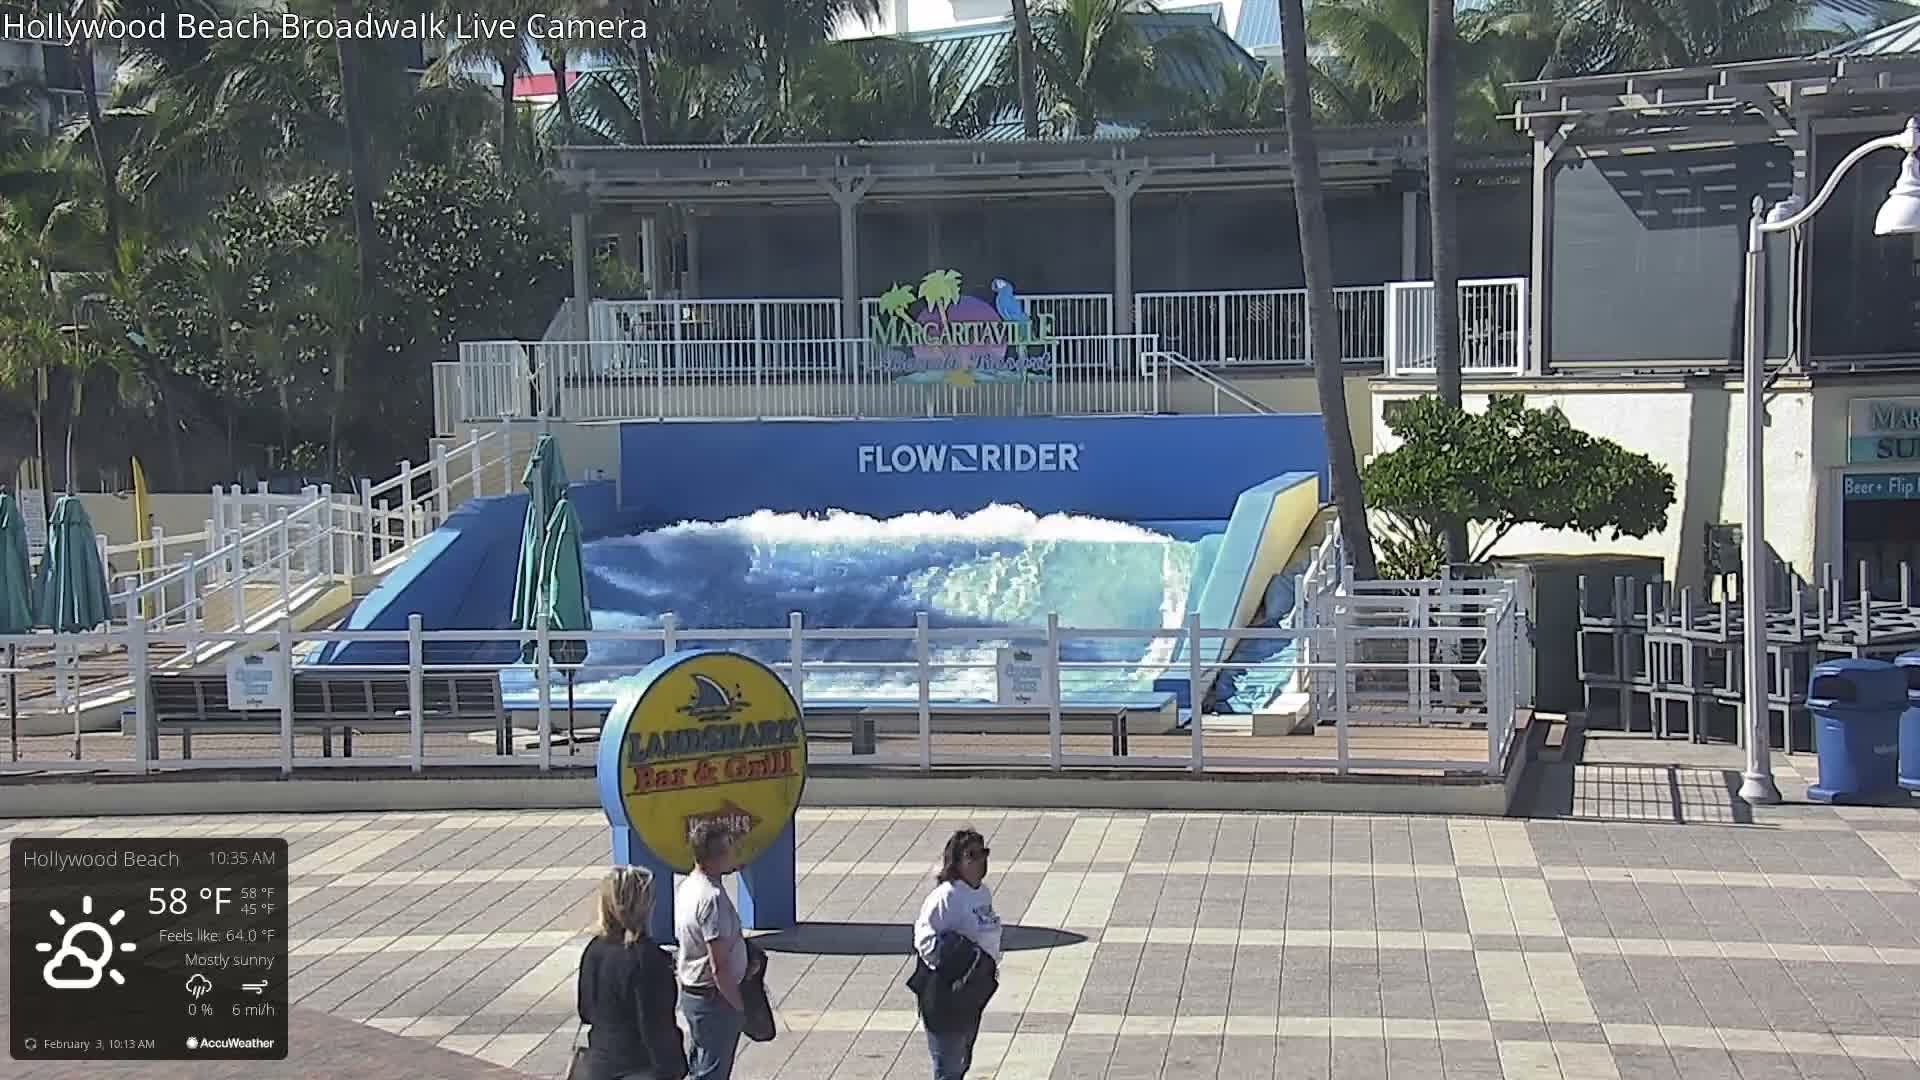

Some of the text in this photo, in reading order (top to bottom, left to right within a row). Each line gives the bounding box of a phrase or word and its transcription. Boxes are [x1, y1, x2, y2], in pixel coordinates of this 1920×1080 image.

[858, 443, 1080, 473] FLOW RIDER
[1889, 477, 1913, 500] Flip
[628, 718, 798, 765] LANDSHARK
[633, 750, 793, 791] Bar & Grill
